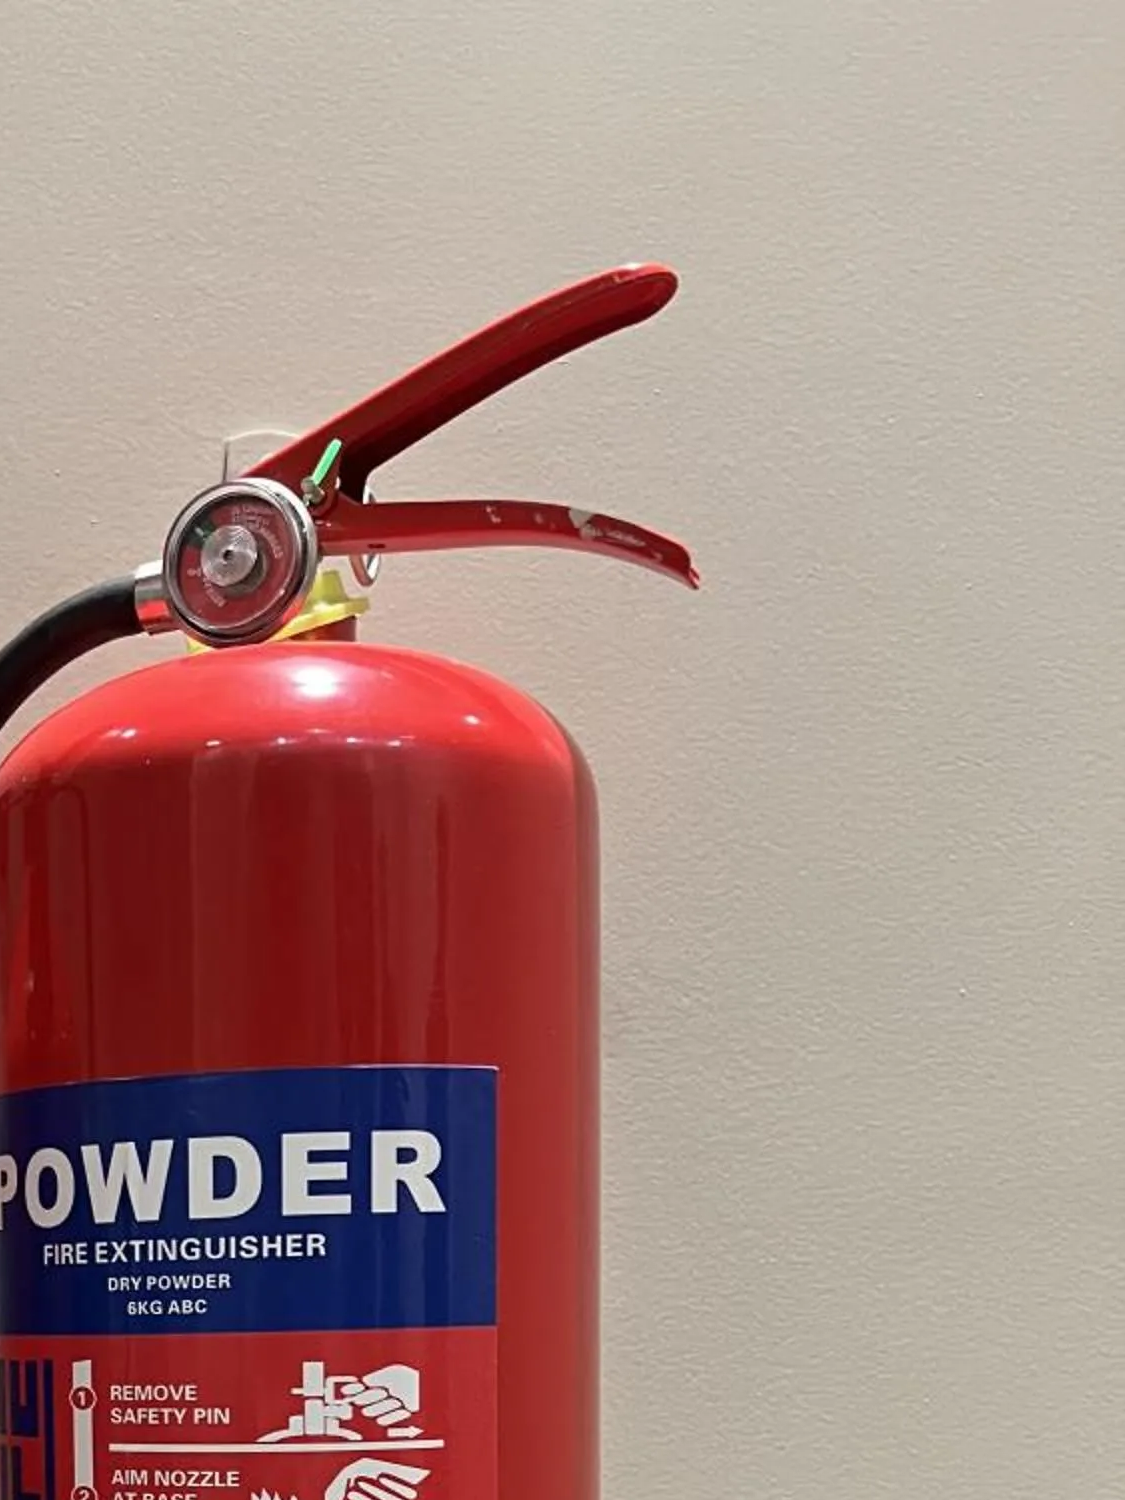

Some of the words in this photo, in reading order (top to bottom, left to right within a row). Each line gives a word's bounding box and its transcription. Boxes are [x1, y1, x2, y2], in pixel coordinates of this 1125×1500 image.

[43, 1238, 88, 1265] FIRE
[96, 1233, 327, 1264] EXTINGUISHER
[108, 1274, 142, 1292] DRY
[146, 1273, 231, 1291] POWDER
[127, 1301, 163, 1316] 6KG
[168, 1300, 207, 1315] ABC
[77, 1390, 88, 1407] 1
[110, 1385, 197, 1402] REMOVE
[110, 1408, 188, 1425] SAFETY
[194, 1407, 230, 1425] PIN
[111, 1470, 148, 1487] AIM
[155, 1470, 240, 1487] NOZZLE
